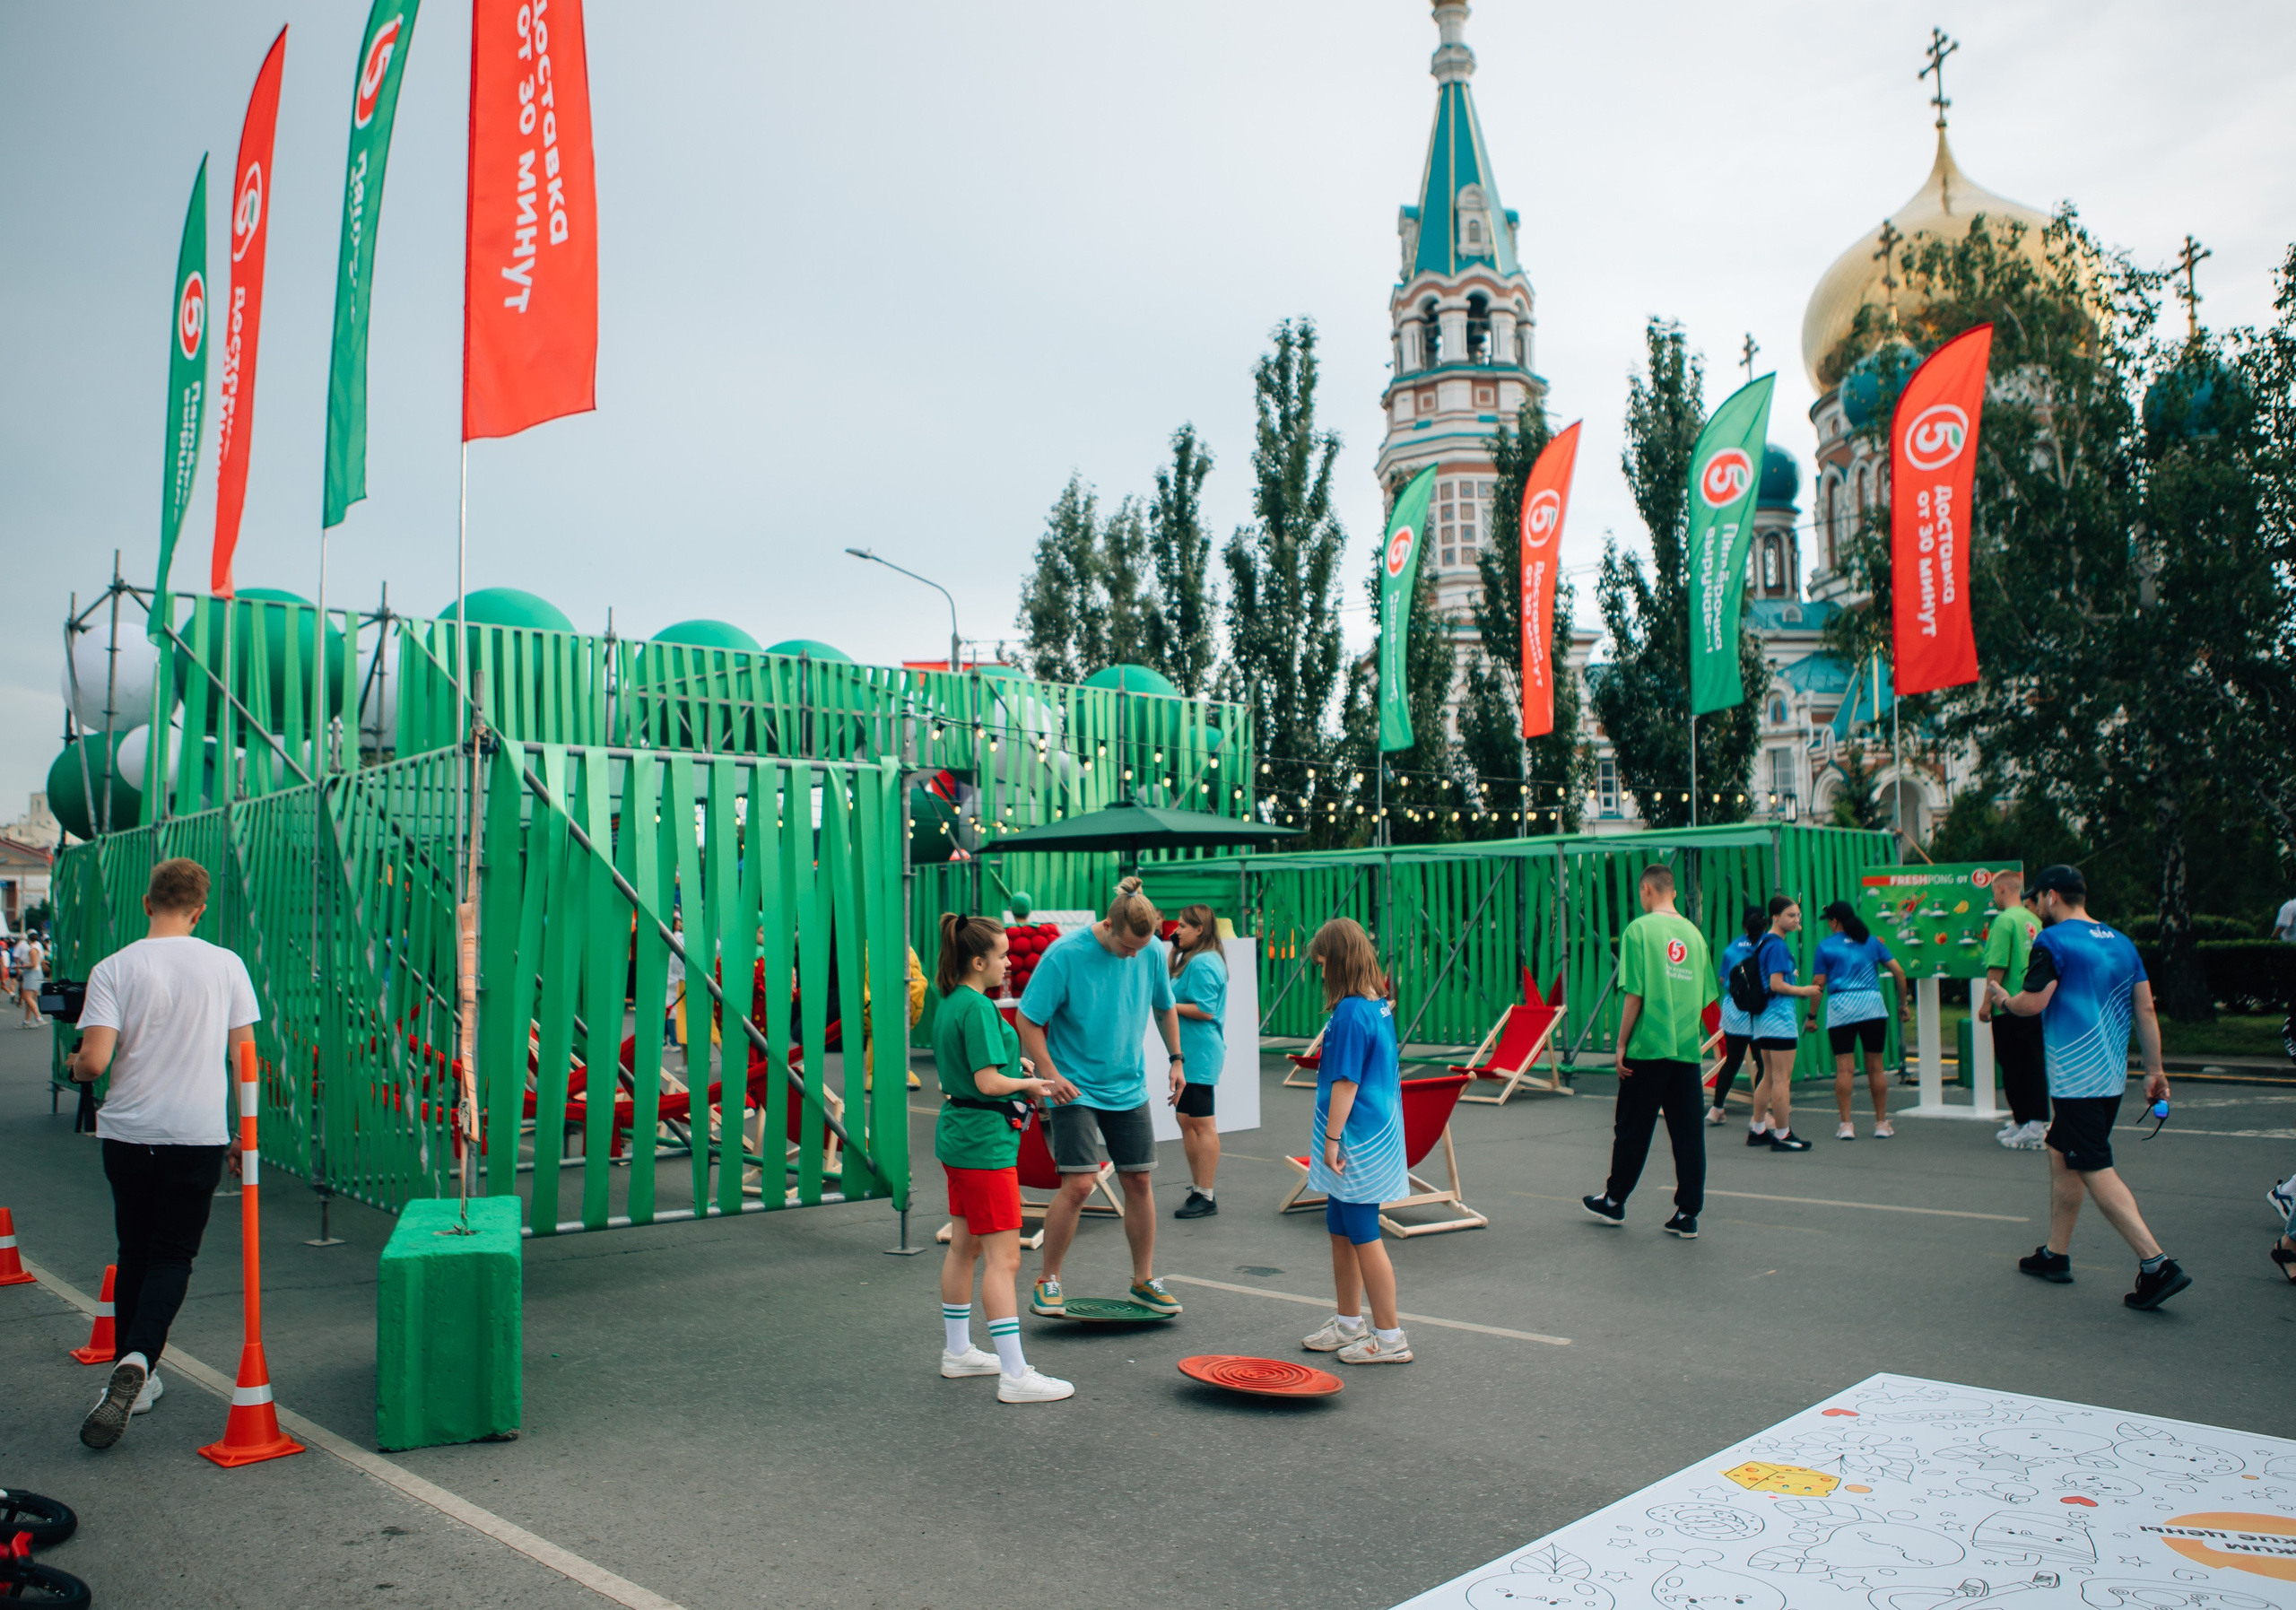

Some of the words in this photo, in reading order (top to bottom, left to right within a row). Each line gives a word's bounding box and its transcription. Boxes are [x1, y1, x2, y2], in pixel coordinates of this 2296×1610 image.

[517, 4, 532, 61] от
[518, 74, 536, 135] 30
[501, 148, 537, 314] минут
[1917, 491, 1930, 519] от
[1918, 522, 1935, 553] 30
[1934, 484, 1955, 605] Доставка
[1526, 564, 1533, 587] от
[1917, 557, 1937, 638] минут
[1531, 561, 1545, 661] Доставка
[1890, 874, 1954, 886] FRESHPONG
[1957, 875, 1968, 884] от
[2139, 1526, 2228, 1539] цены
